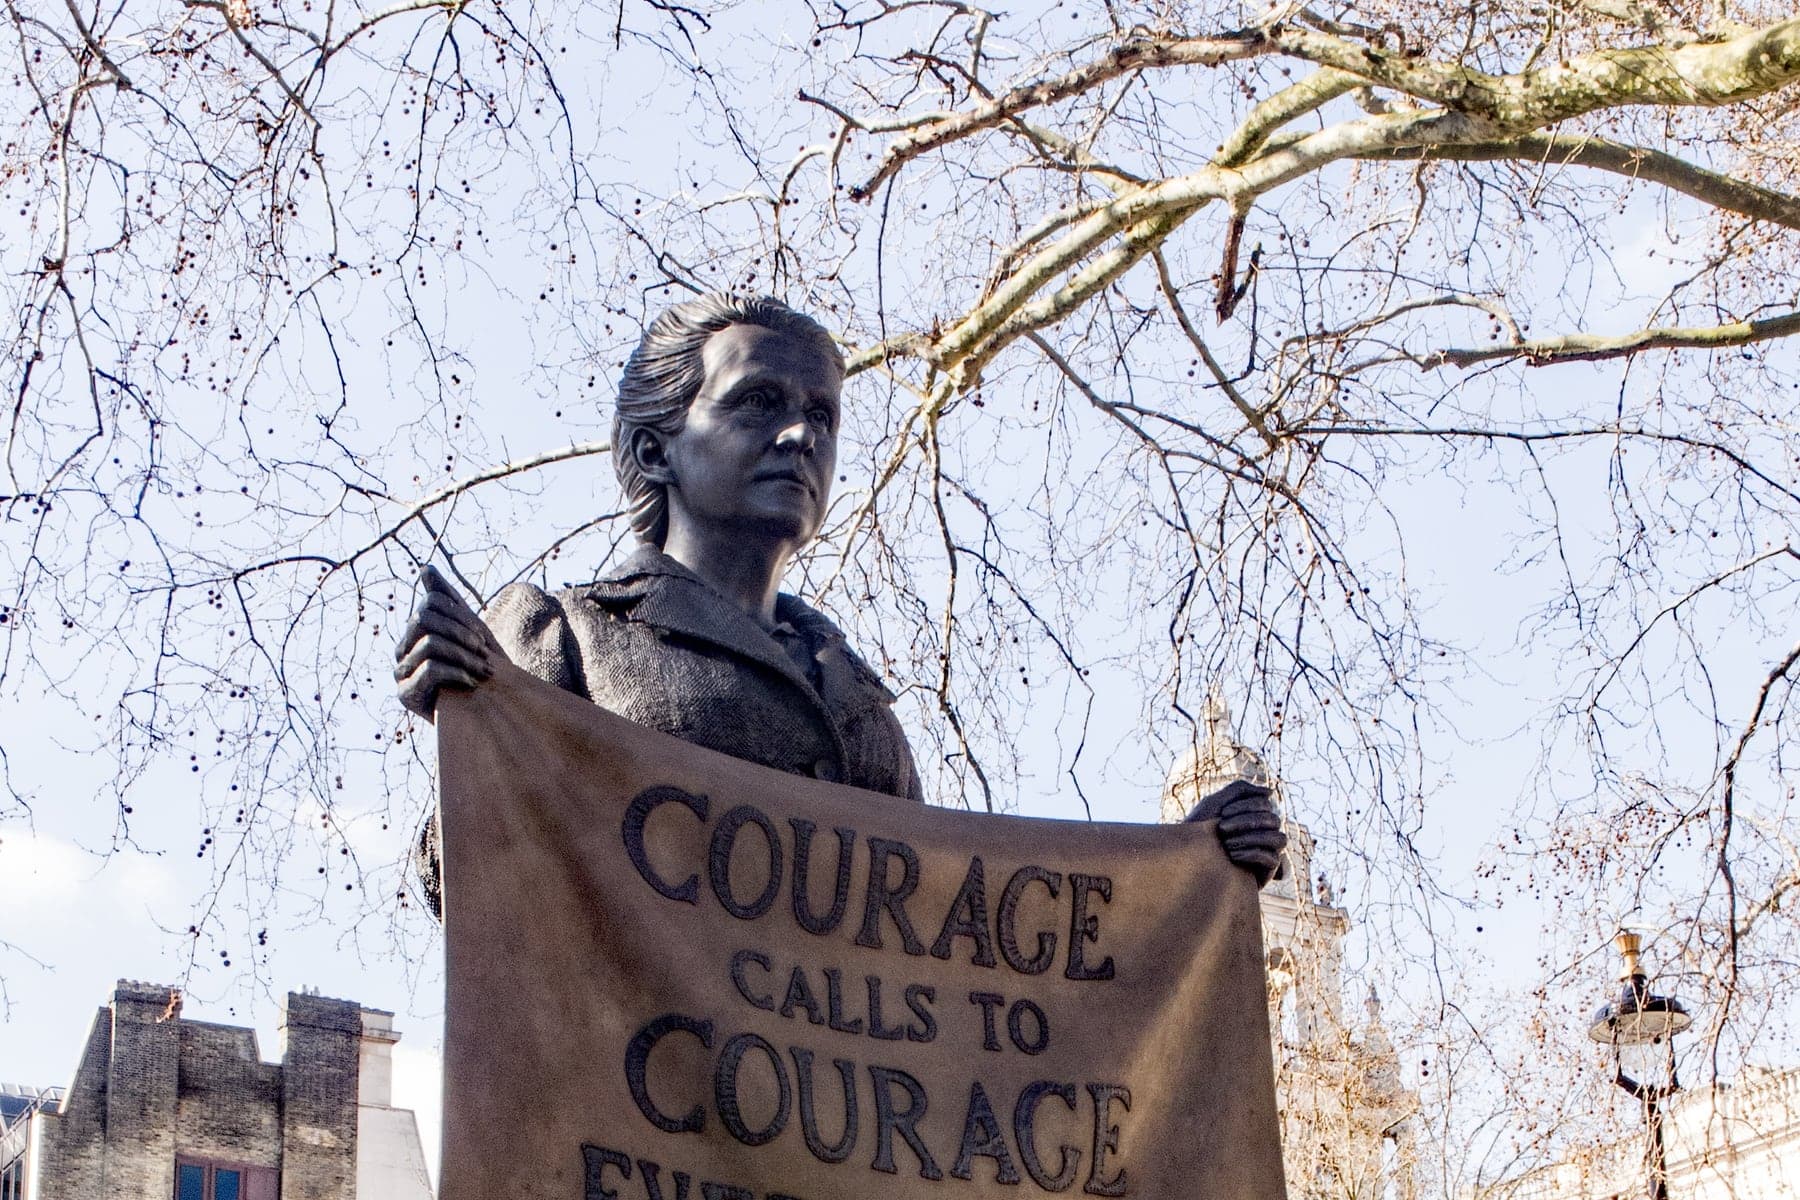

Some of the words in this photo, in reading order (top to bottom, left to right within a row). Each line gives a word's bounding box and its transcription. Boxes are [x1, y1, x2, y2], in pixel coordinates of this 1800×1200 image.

[621, 785, 1115, 981] COURAGE
[730, 950, 936, 1042] CALLS
[969, 991, 1050, 1055] TO
[624, 1013, 1132, 1197] COURAGE
